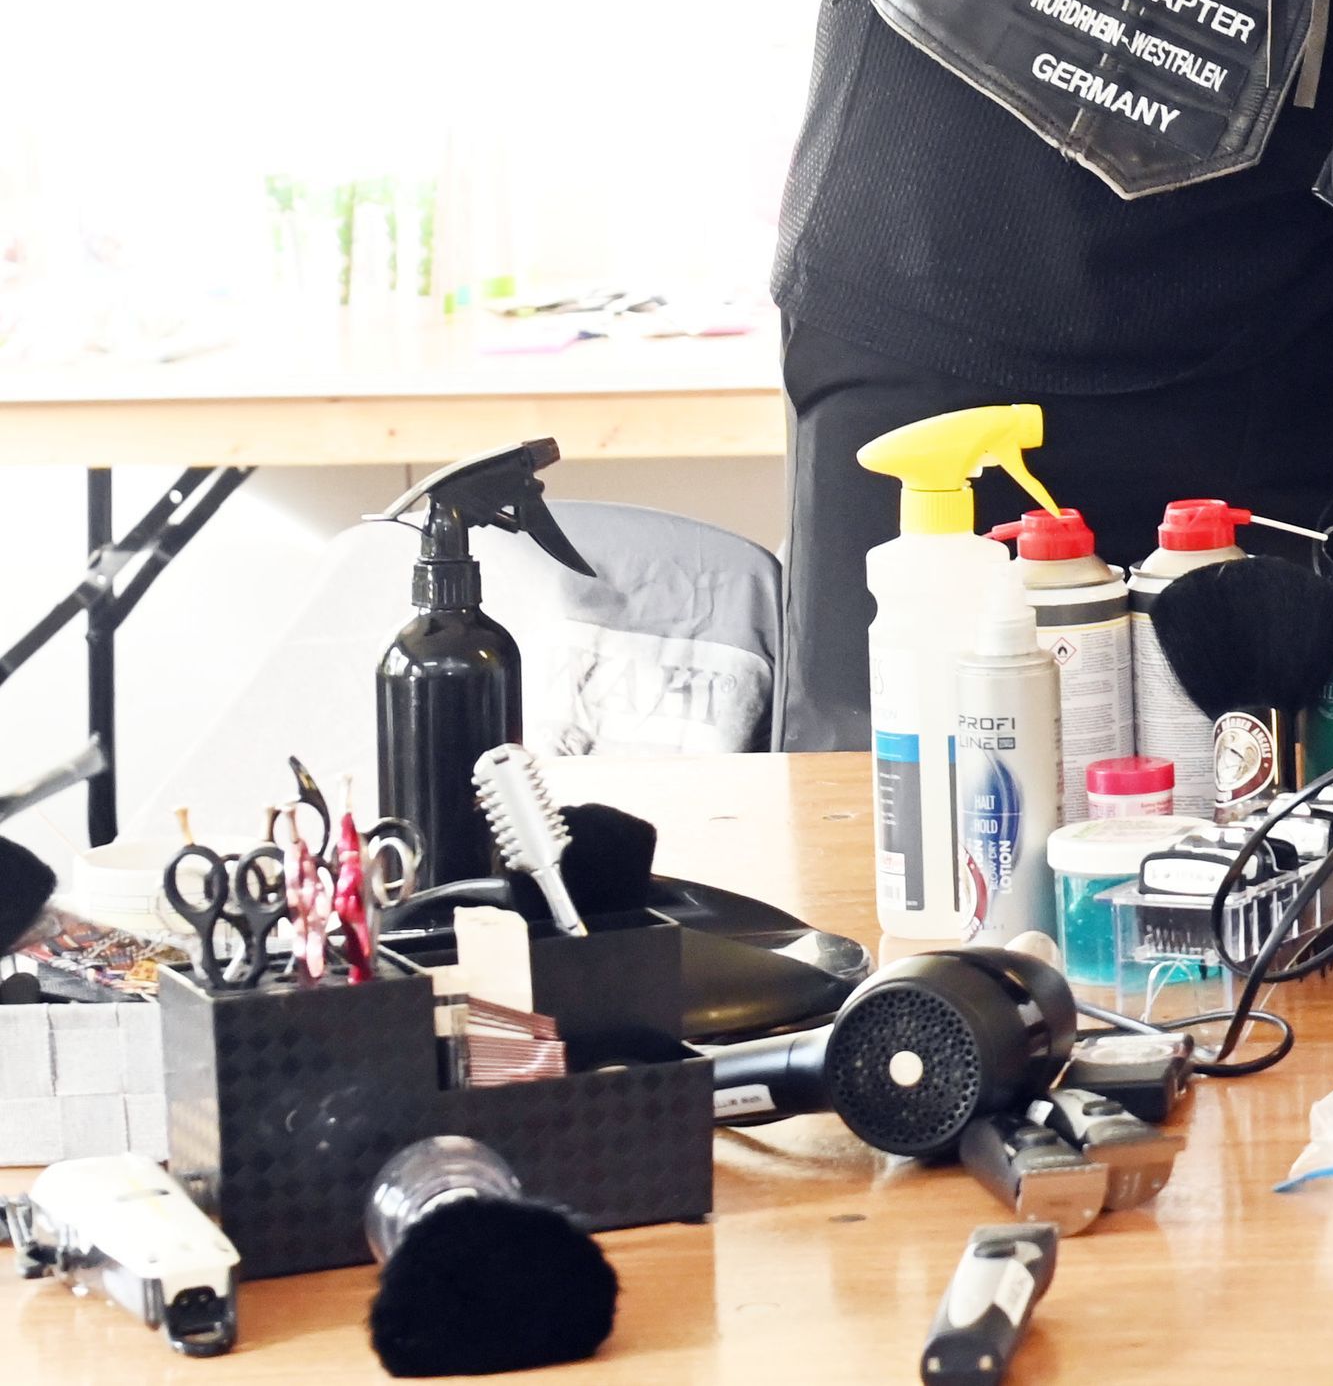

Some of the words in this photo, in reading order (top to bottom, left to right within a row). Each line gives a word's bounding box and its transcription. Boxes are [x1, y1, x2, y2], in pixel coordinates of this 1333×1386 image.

[1031, 52, 1181, 135] GERMANY
[959, 714, 1016, 731] PROFI
[959, 736, 995, 750] LINE
[974, 794, 996, 811] HALT
[999, 839, 1013, 895] LOTION
